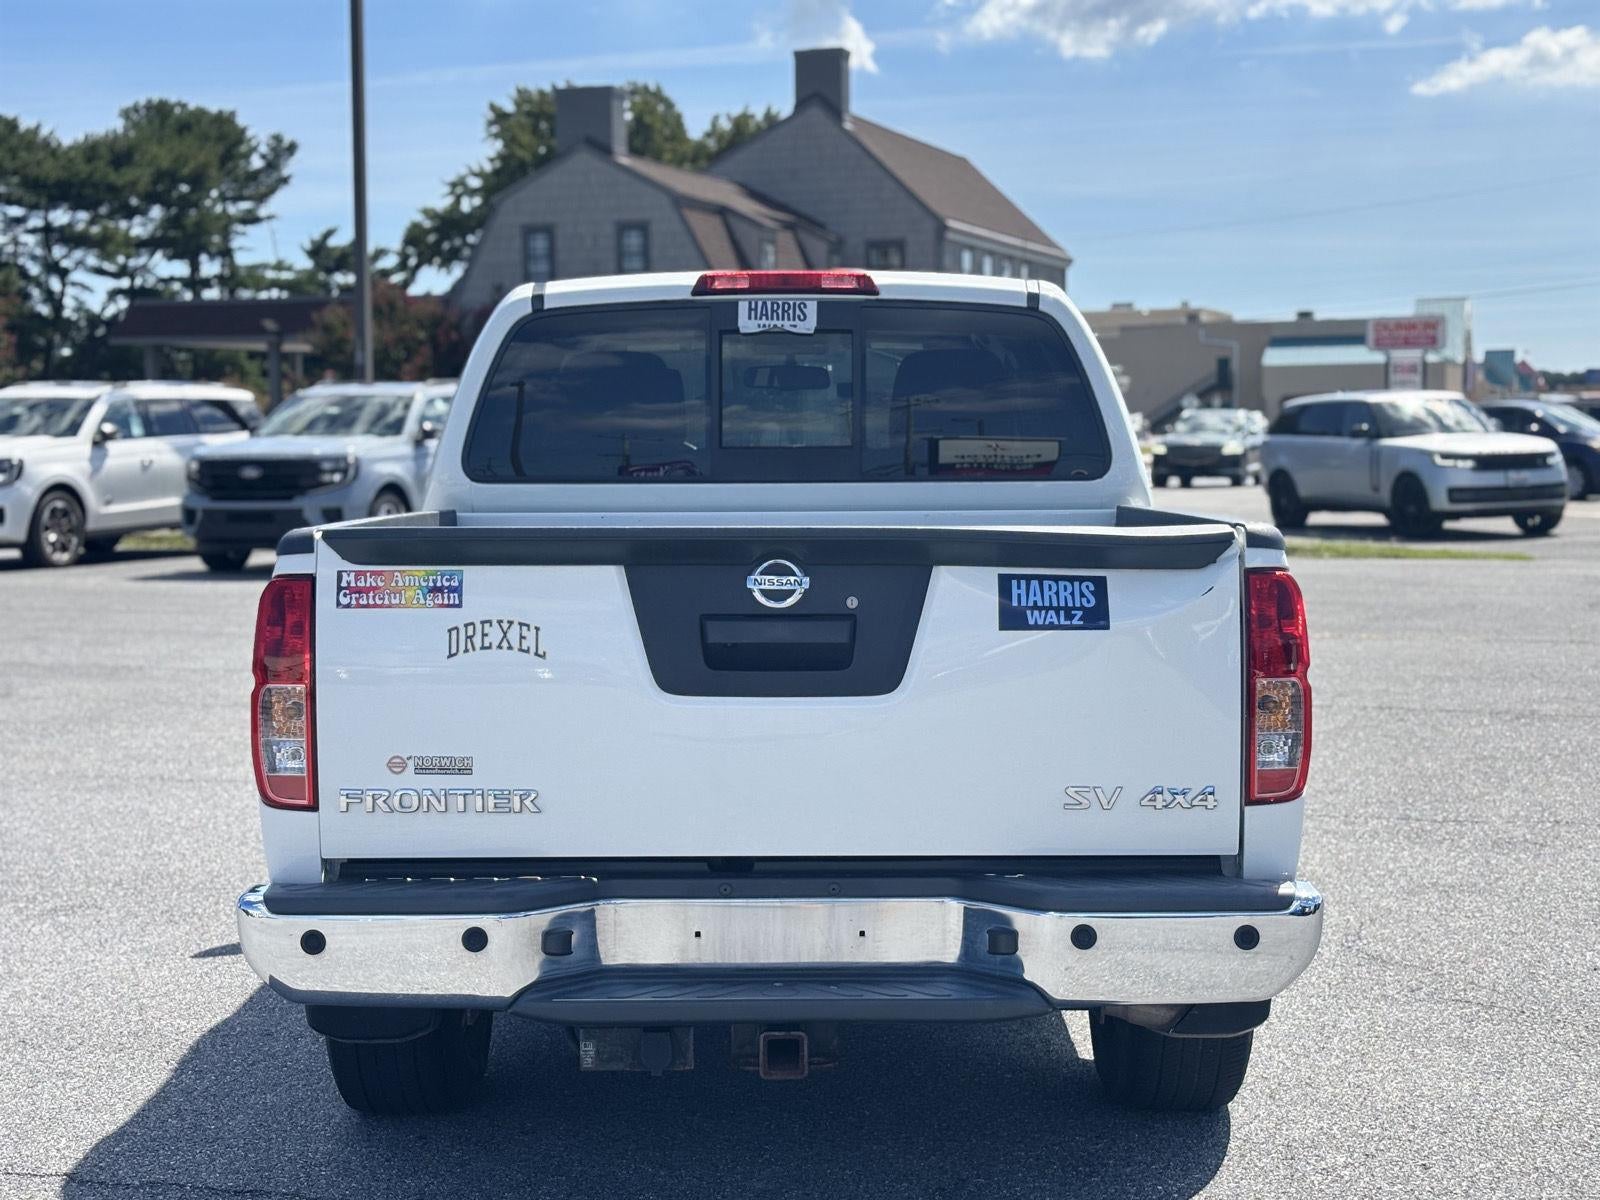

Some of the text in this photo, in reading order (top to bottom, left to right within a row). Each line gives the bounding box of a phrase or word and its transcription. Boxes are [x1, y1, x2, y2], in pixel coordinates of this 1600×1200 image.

[747, 301, 808, 322] HARRIS
[340, 571, 459, 587] Make America
[753, 577, 803, 586] NISSAN
[338, 589, 460, 607] Grateful Again
[1011, 579, 1096, 607] HARRIS
[1027, 610, 1084, 625] WALZ
[446, 619, 547, 660] DREXEL
[414, 756, 473, 767] NORWICH
[339, 788, 541, 813] FRONTIER
[1063, 786, 1123, 810] SV
